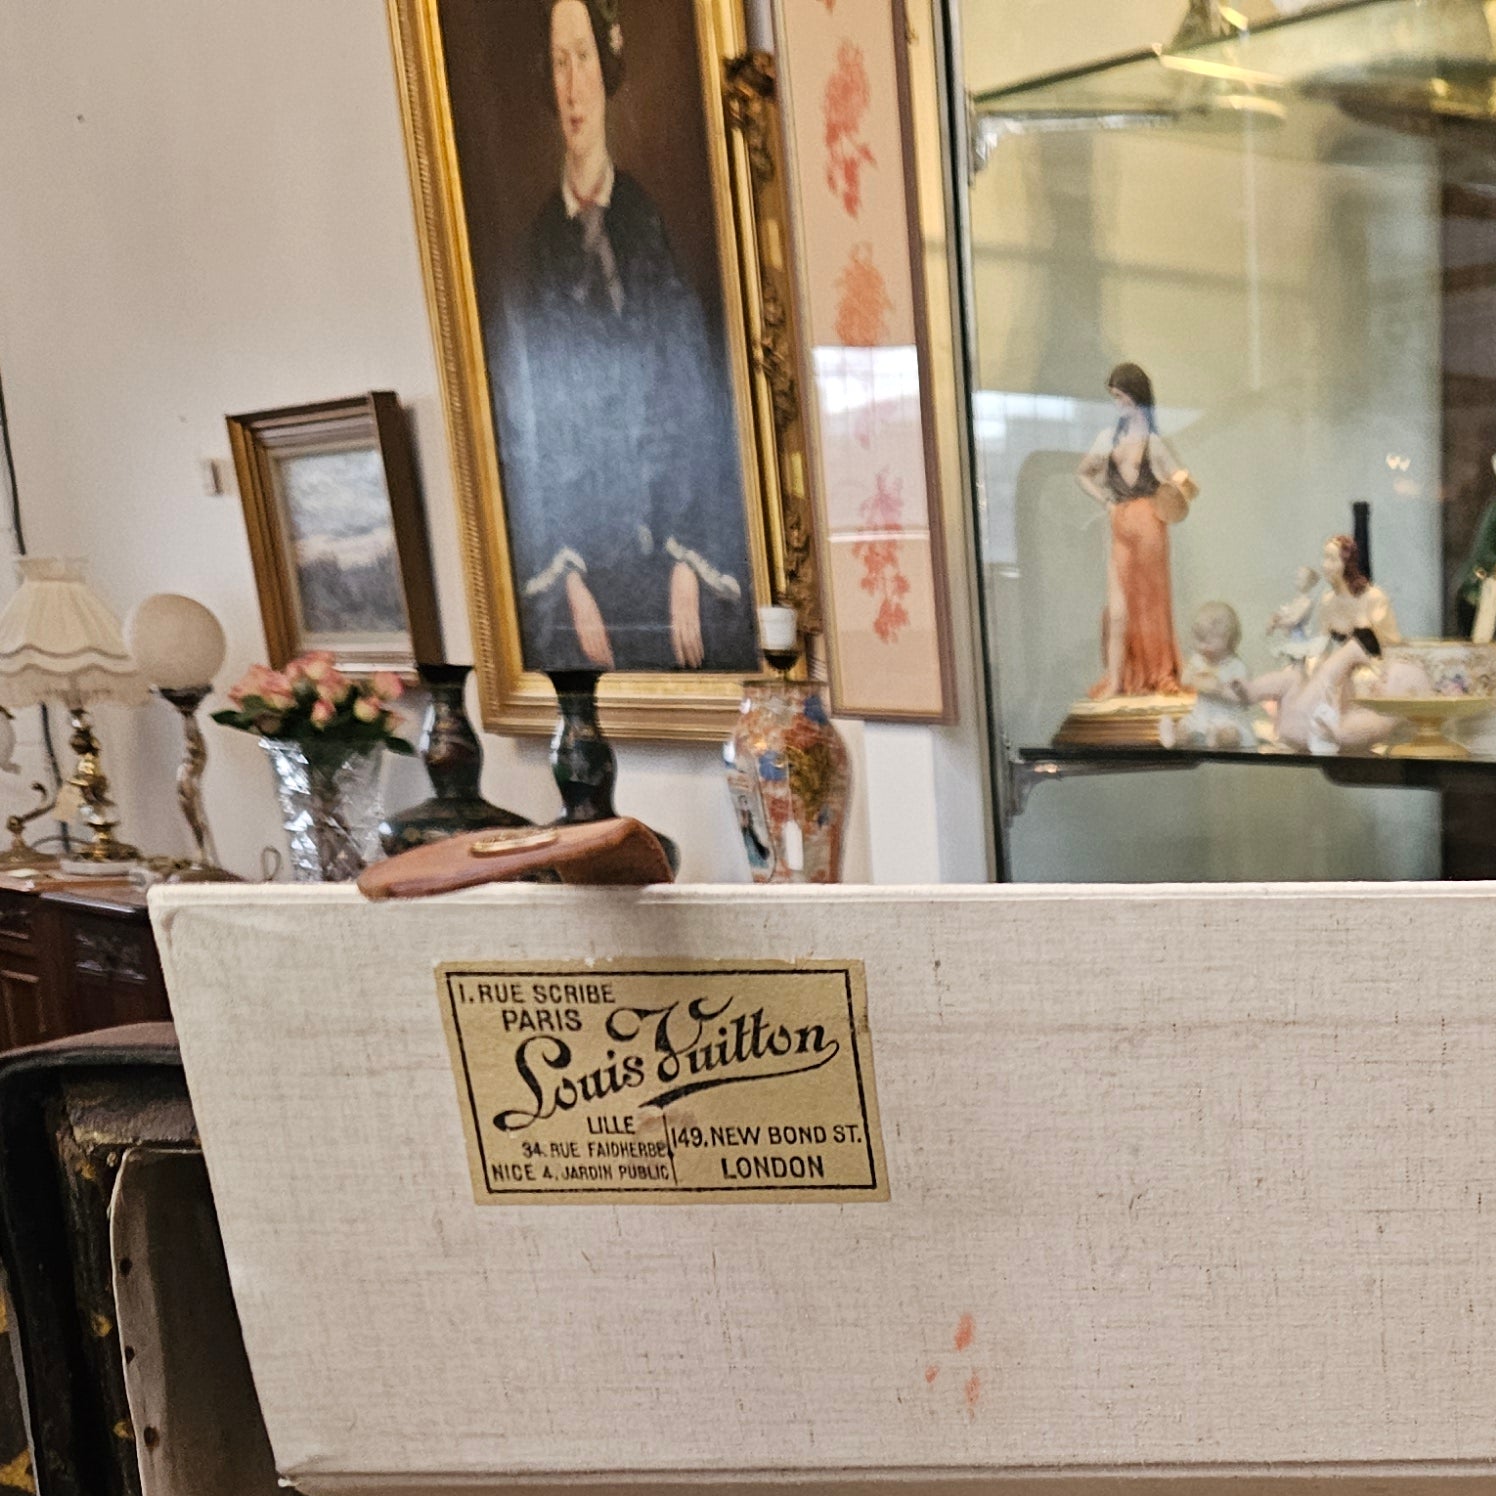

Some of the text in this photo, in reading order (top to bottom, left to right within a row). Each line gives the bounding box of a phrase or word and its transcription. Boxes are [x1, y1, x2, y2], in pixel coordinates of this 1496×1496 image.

[478, 985, 524, 1004] RUE
[534, 984, 616, 1004] SCRIBE
[502, 1009, 582, 1032] PARIS
[493, 996, 840, 1131] Louis Vuitton
[587, 1116, 636, 1134] LILLE
[671, 1125, 862, 1148] 149. NEW BOND ST.
[551, 1143, 578, 1158] RUE
[588, 1142, 667, 1158] FAIDHERBE
[492, 1164, 533, 1181] NICE
[562, 1164, 613, 1181] JARDIN
[618, 1164, 669, 1181] PUBLIC
[722, 1157, 824, 1179] LONDON
